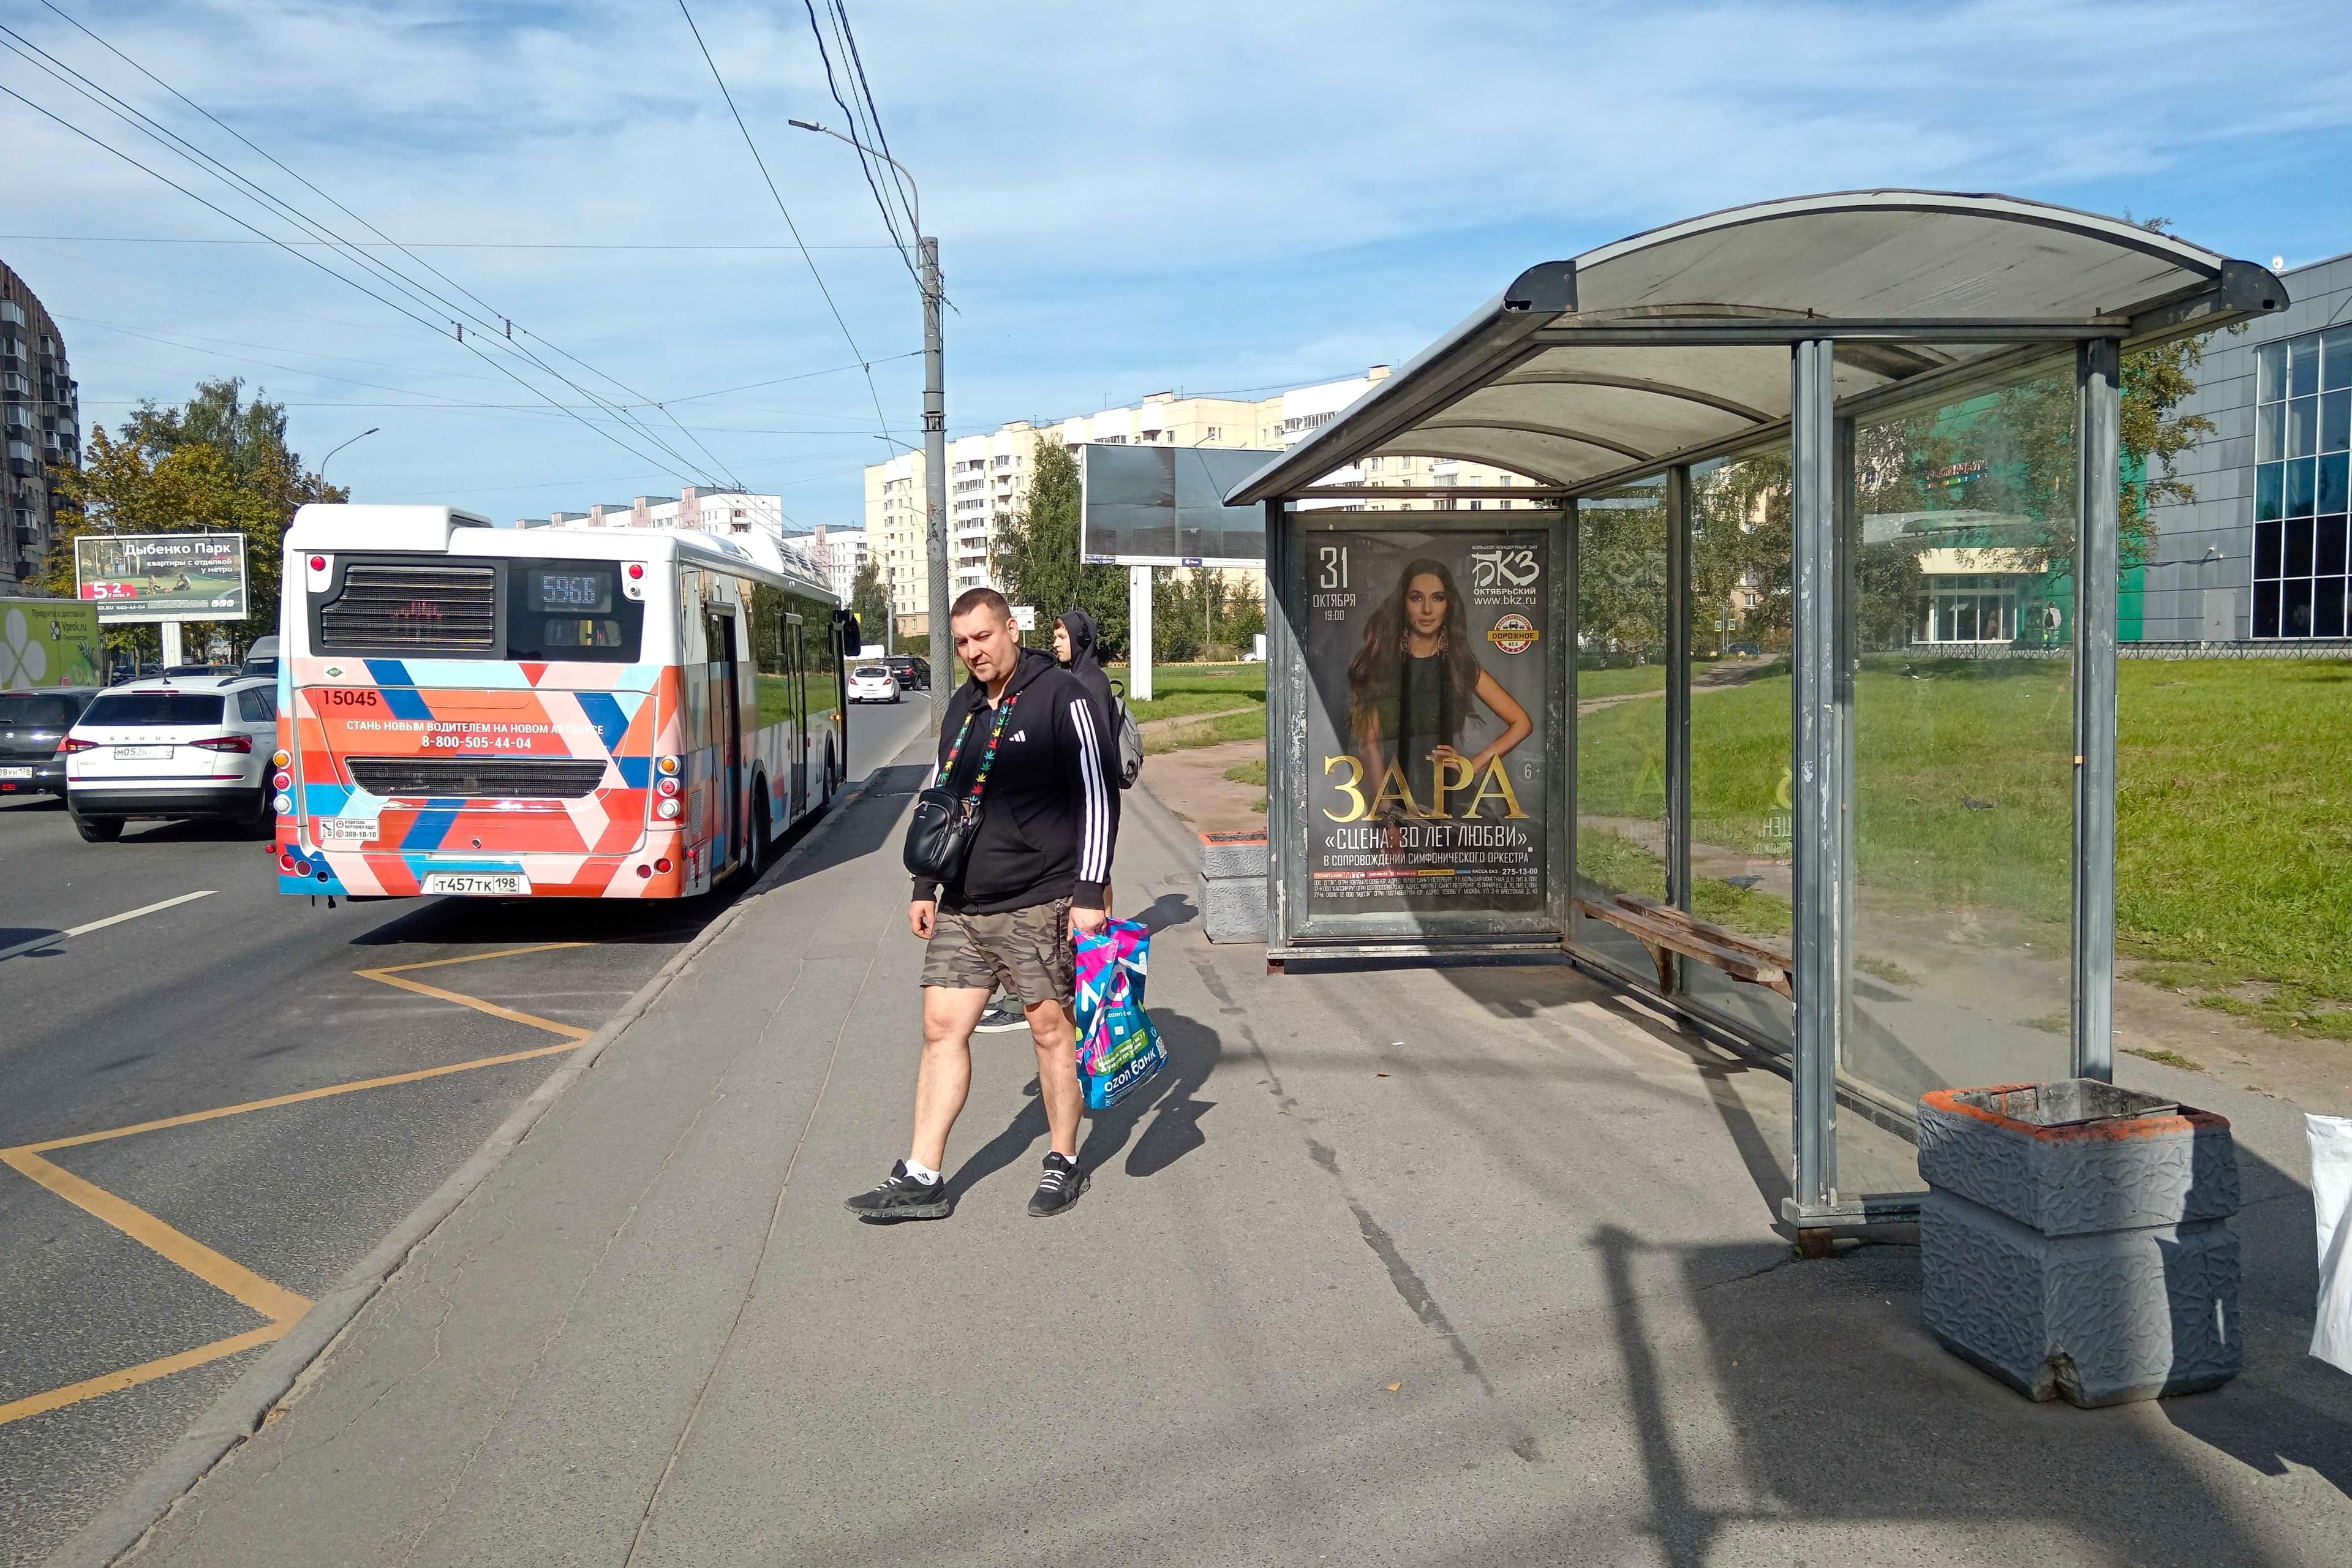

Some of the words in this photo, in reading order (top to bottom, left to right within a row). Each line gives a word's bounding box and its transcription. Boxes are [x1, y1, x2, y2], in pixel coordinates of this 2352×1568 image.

[125, 543, 190, 557] Дыбенко
[195, 543, 232, 556] Парк
[1320, 546, 1348, 588] 31
[1471, 550, 1540, 588] БКЗ
[1473, 587, 1536, 595] ОКТЯБРЬСКИЙ
[1313, 594, 1356, 608] ОКТЯБРЯ
[1474, 595, 1536, 605] www.bkz.ru
[1325, 610, 1344, 621] 19:00
[61, 621, 87, 633] Vprok.ru
[323, 690, 377, 706] 15045
[347, 720, 382, 731] СТАНЬ
[384, 721, 424, 731] НОВЫМ
[427, 722, 491, 733] ВОДИТЕЛЕМ
[493, 724, 508, 733] НА
[510, 724, 548, 734] НОВОМ
[421, 736, 532, 749] 8-800-505-44-04
[1322, 753, 1530, 823] ЗАРА
[1324, 827, 1393, 851] «СЦЕНА:
[1399, 827, 1419, 848] 30
[1425, 826, 1452, 848] ЛЕТ
[1458, 825, 1528, 848] ЛЮБВИ»
[1324, 855, 1329, 866] В
[1332, 853, 1406, 867] СОПРОВОЖДЕНИИ
[1408, 852, 1485, 864] СИМФОНИЧЕСКОГО
[1488, 851, 1529, 863] ОРКЕСТРА
[439, 877, 492, 891] Т457ТК
[495, 877, 516, 888] 198
[1104, 1069, 1131, 1092] ozon
[1131, 1047, 1156, 1075] банк
